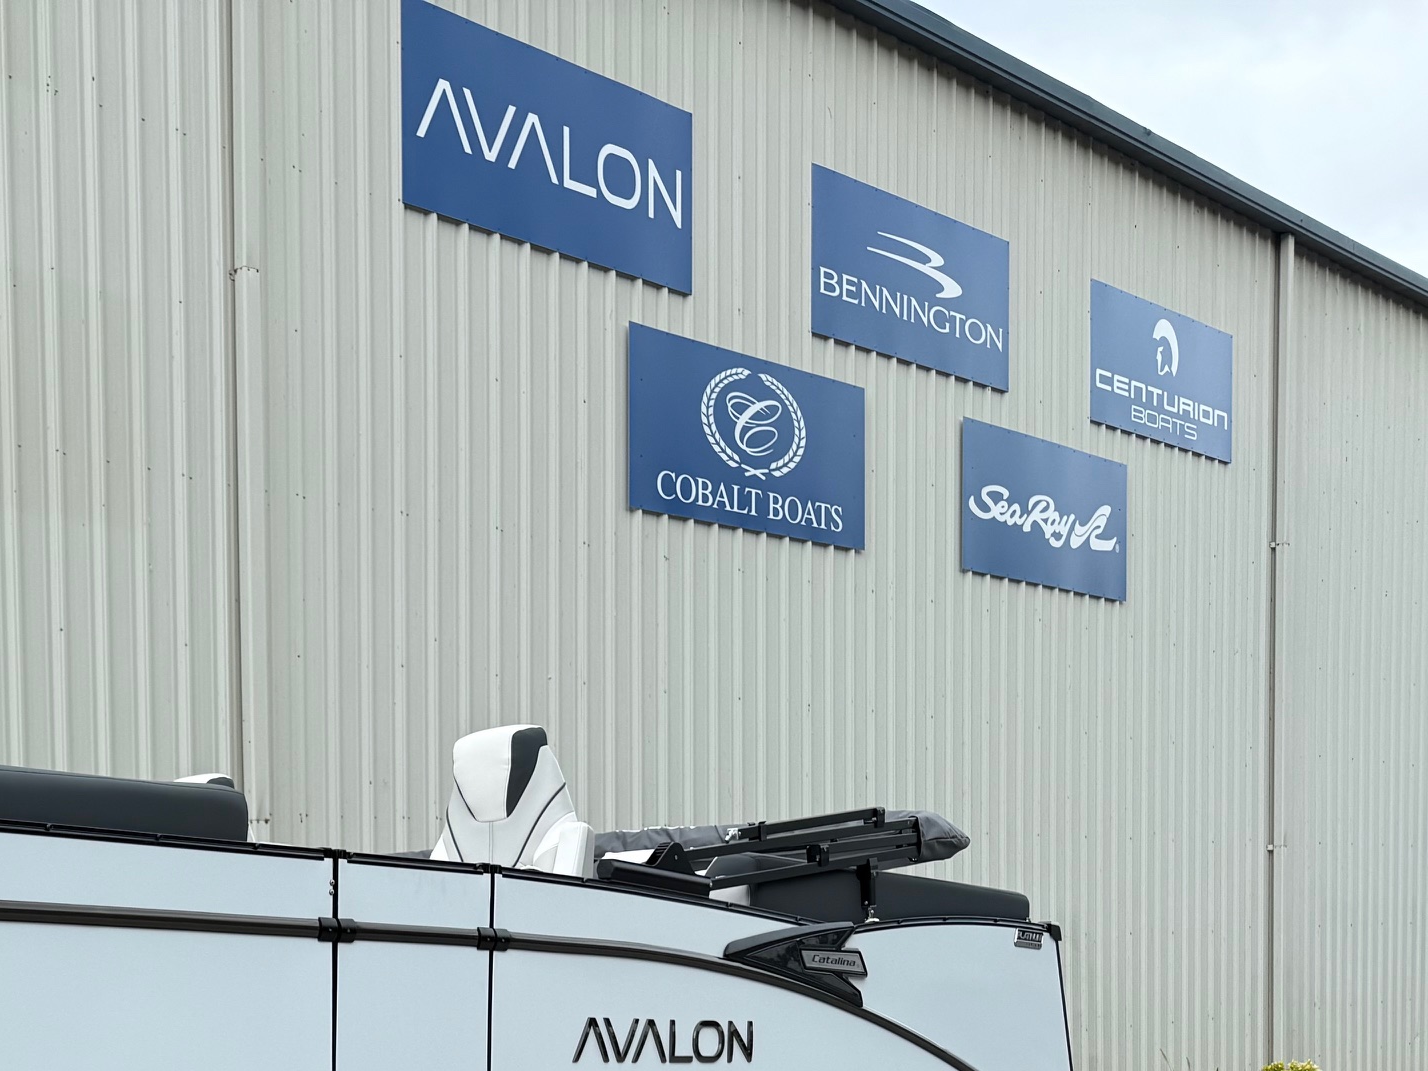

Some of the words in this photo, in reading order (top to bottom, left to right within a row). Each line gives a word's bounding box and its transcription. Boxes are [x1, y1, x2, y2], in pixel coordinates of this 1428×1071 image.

[416, 78, 682, 229] AVALON
[819, 266, 1003, 353] BENNINGTON
[1095, 368, 1228, 430] CENTURION
[1131, 405, 1197, 441] BOATS
[656, 470, 763, 516] COBALT
[767, 492, 843, 532] BOATS
[812, 954, 856, 967] Catalina
[572, 1017, 754, 1064] AVALON
